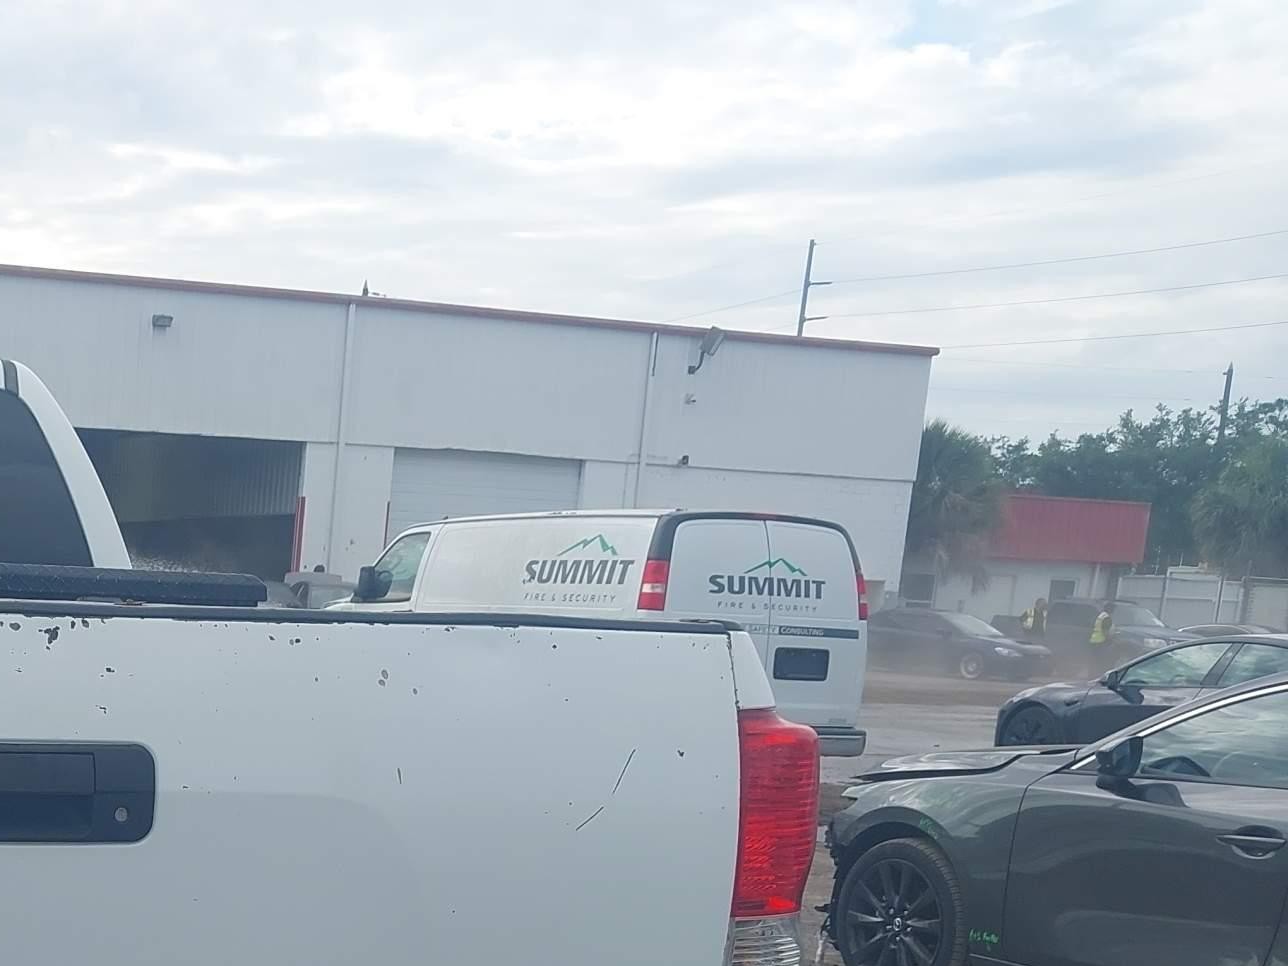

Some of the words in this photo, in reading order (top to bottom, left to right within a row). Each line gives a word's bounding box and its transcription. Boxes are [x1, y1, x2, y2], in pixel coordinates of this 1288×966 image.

[522, 559, 635, 585] SUMMIT
[708, 574, 826, 600] SUMMIT
[523, 592, 547, 602] FIRE
[562, 593, 616, 603] SECURITY
[717, 600, 744, 609] FIRE
[763, 602, 817, 613] SECURITY
